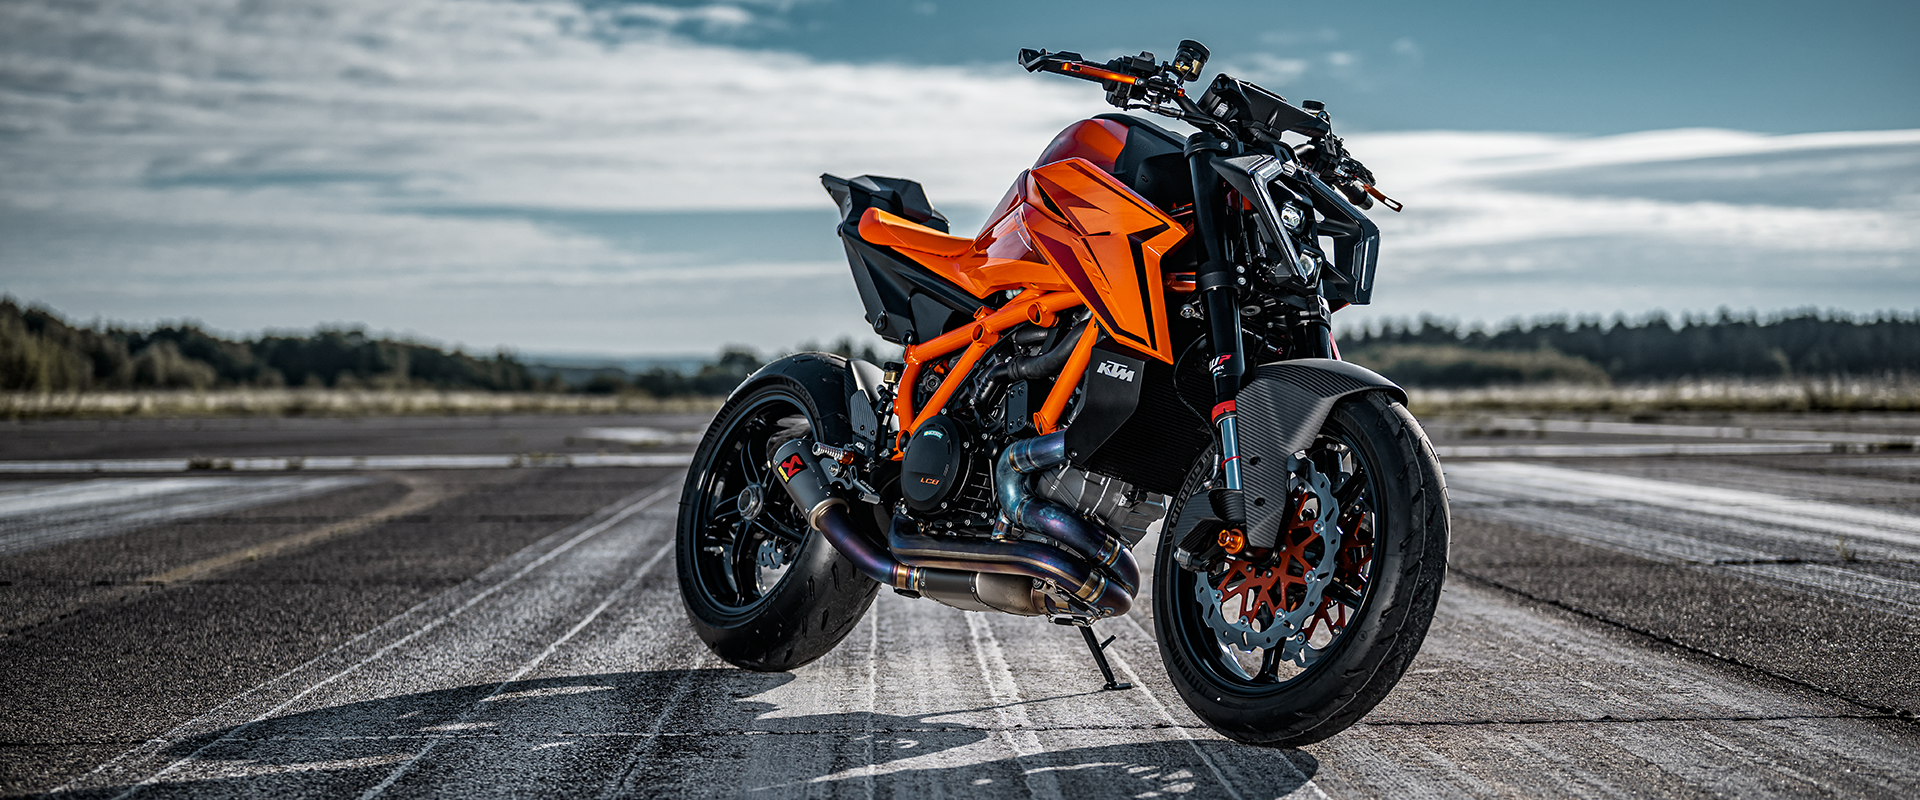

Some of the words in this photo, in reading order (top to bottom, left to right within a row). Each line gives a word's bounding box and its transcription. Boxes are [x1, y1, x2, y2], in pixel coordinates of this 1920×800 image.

[1096, 360, 1135, 382] KTM
[1208, 354, 1232, 372] WP
[1171, 464, 1201, 525] MICHELIN
